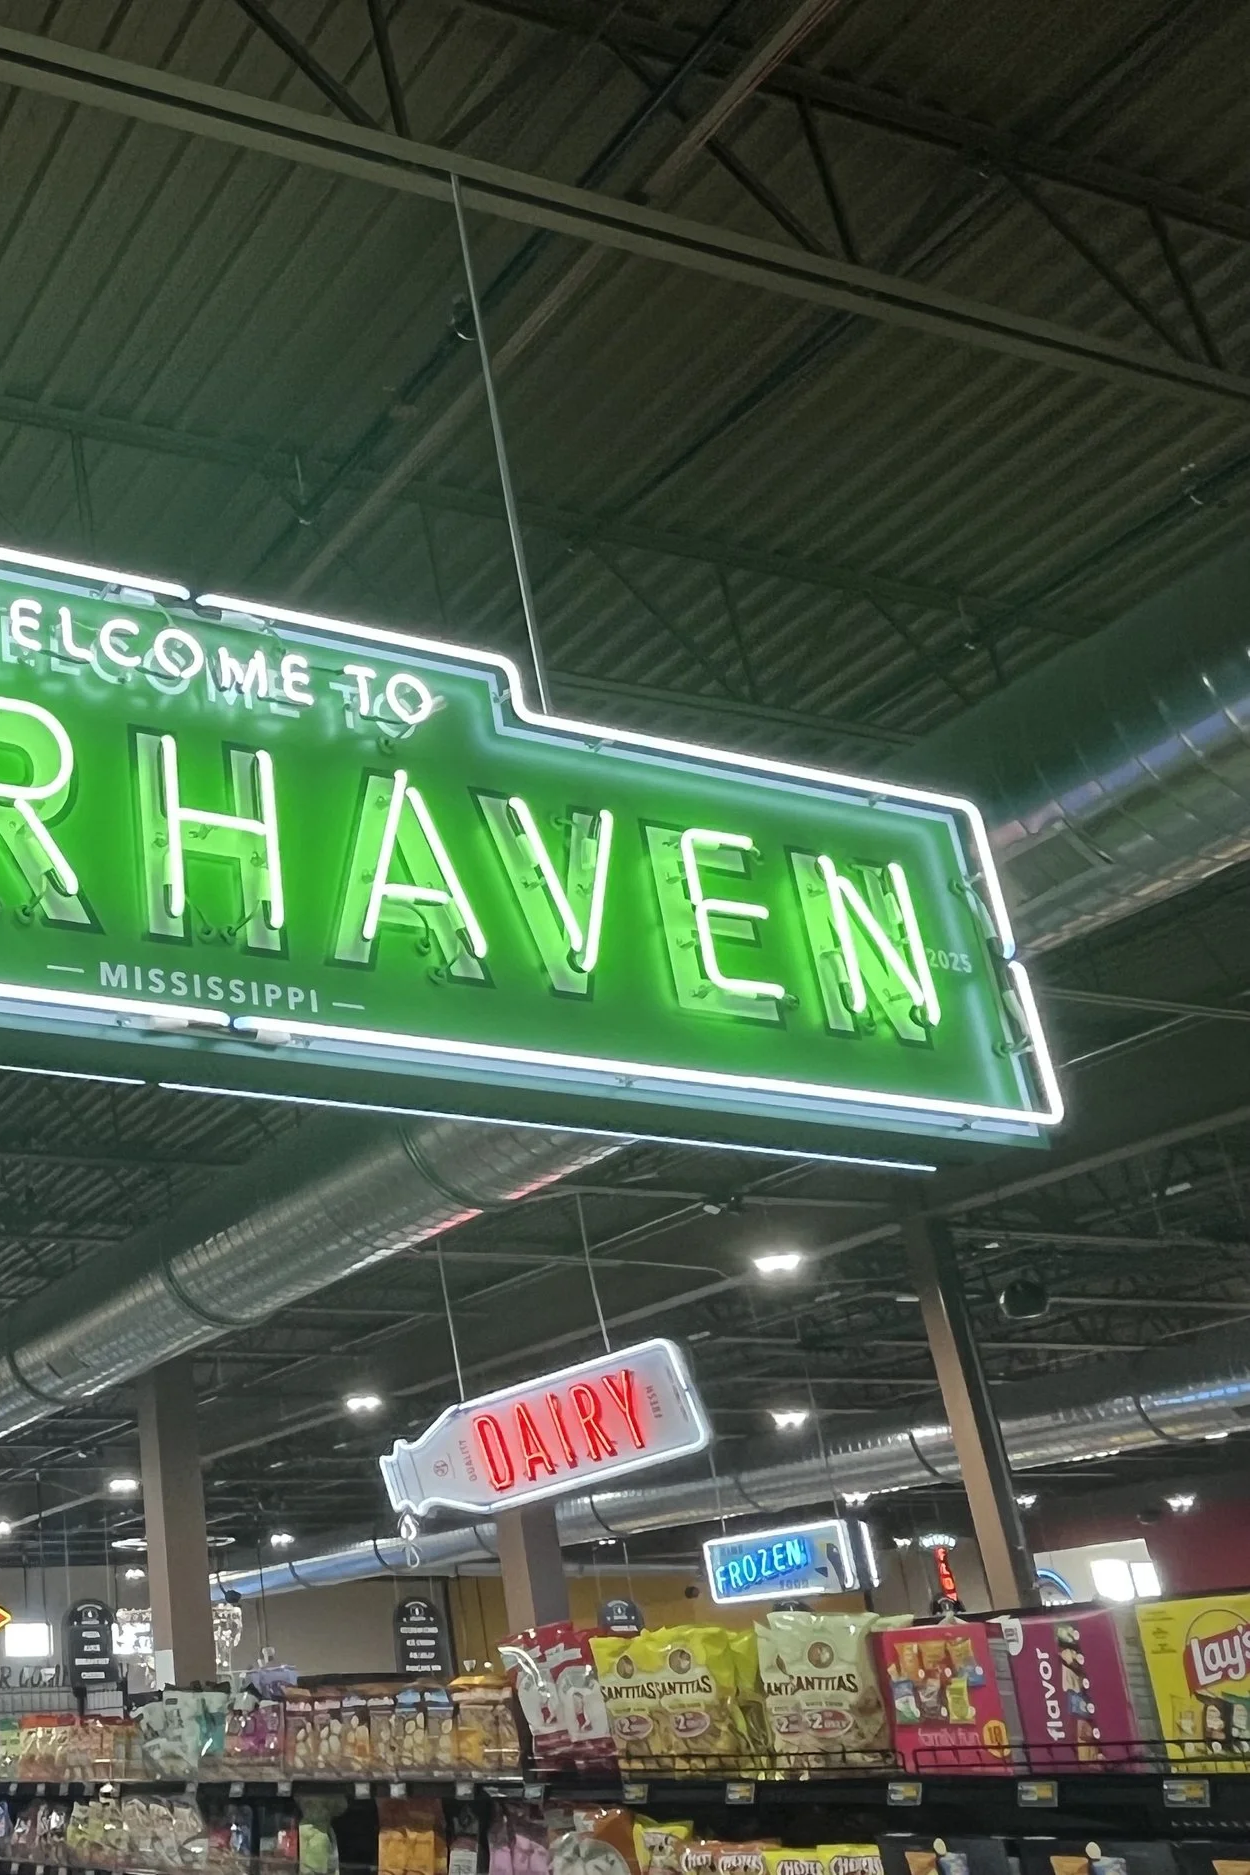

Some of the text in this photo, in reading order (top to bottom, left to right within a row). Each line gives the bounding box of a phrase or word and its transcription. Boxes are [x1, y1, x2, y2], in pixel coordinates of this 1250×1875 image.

[335, 663, 434, 730] TO
[925, 947, 973, 974] 2025
[99, 961, 319, 1013] MISSISSIPPI
[472, 1368, 646, 1493] DAIRY
[458, 1439, 478, 1483] QUALITY
[714, 1537, 806, 1596] FROZEN
[599, 1681, 657, 1701] SANTITAS
[655, 1674, 713, 1700] SANTITAS
[1035, 1647, 1066, 1742] flavor
